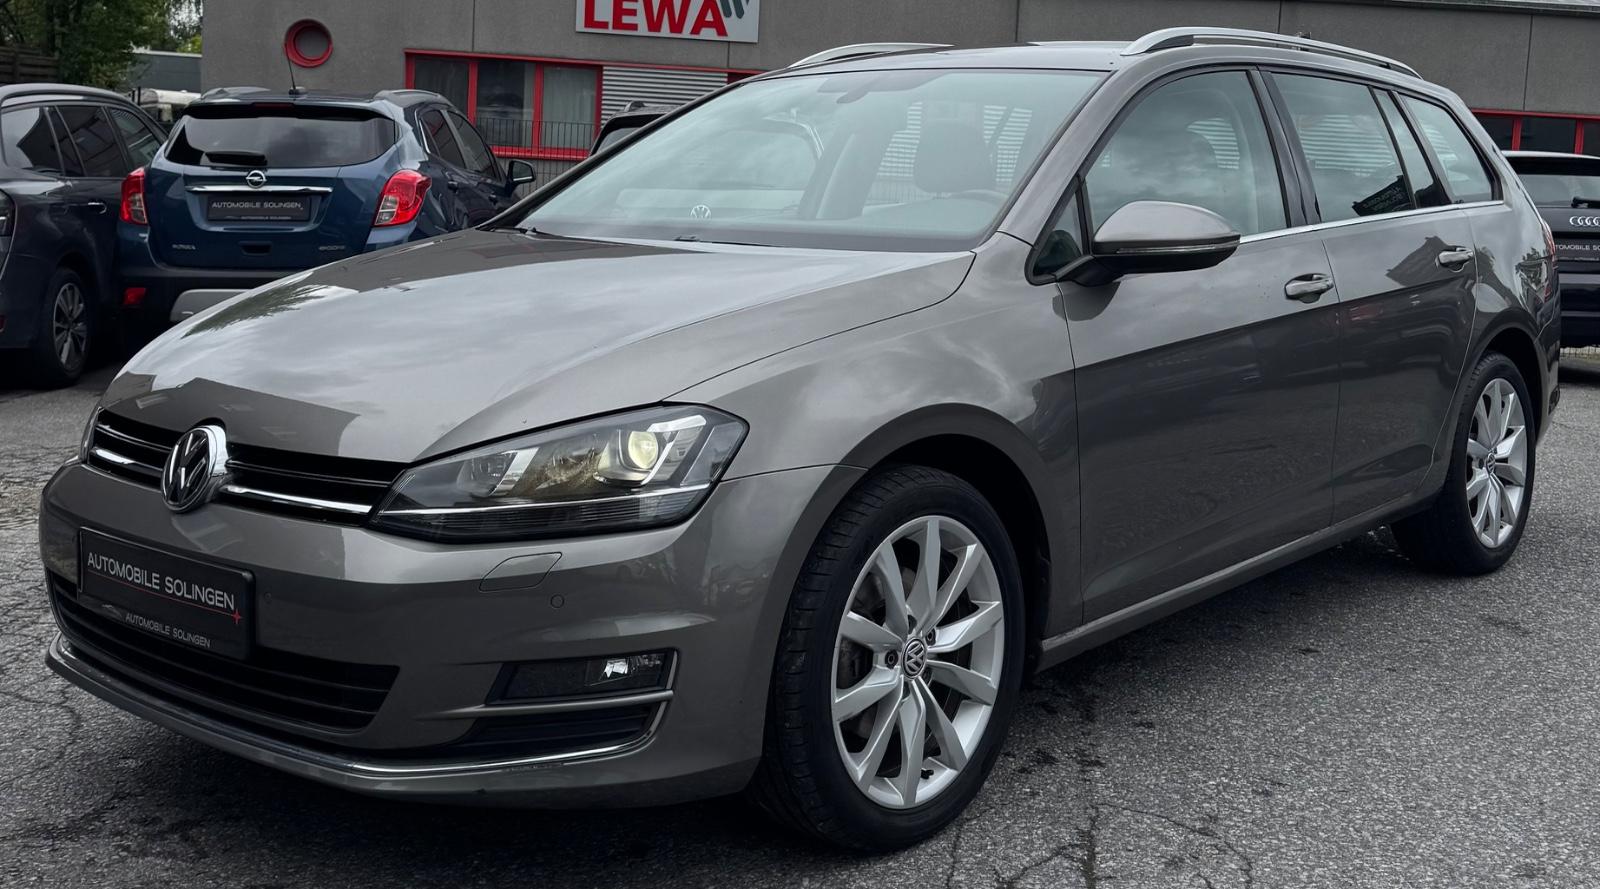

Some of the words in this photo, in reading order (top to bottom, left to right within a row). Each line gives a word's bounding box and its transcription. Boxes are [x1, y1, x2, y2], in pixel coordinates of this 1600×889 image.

[584, 0, 728, 37] LEWA
[87, 552, 160, 590] AUTOMOBILE
[164, 576, 235, 610] SOLINGEN
[125, 612, 170, 636] AUTOMOBILE
[172, 627, 211, 649] SOLINGEN
